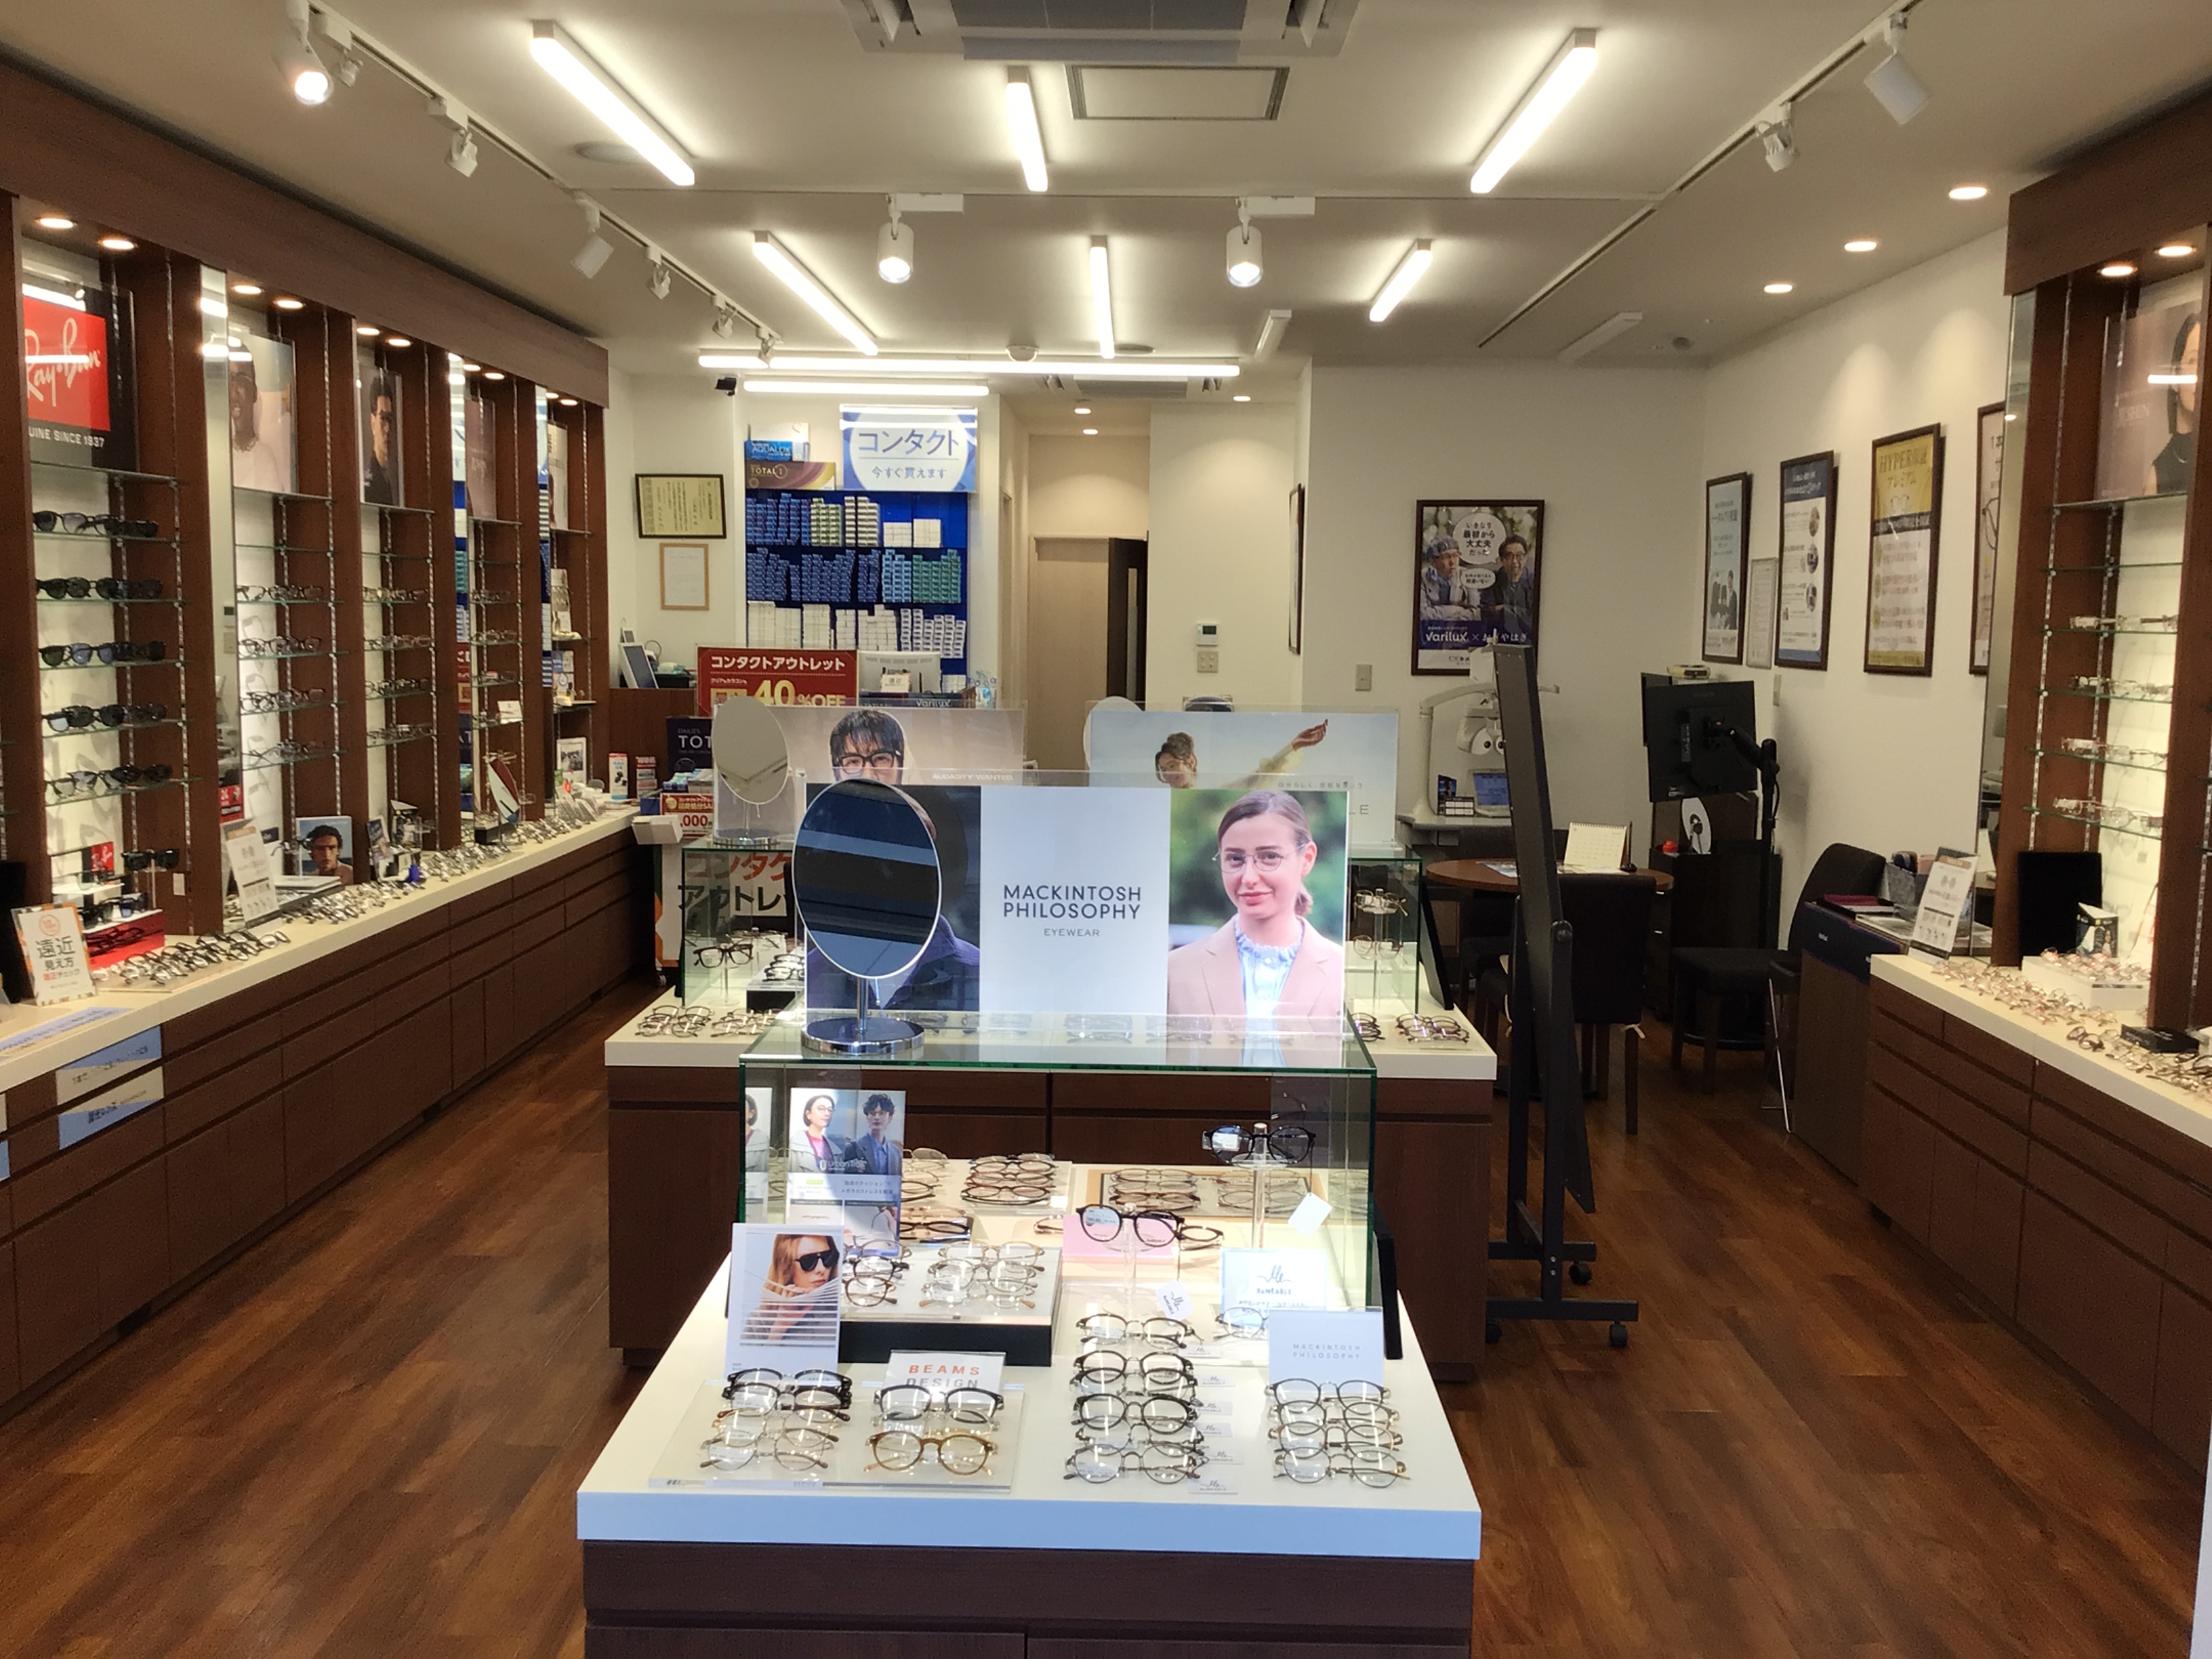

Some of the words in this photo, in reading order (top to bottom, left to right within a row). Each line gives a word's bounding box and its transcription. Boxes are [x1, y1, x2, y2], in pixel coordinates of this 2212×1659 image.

[54, 430, 81, 445] SINCE
[83, 435, 105, 447] 1937
[859, 429, 960, 456] コンタクト
[872, 466, 947, 479] 今すぐ買えます
[1464, 530, 1495, 539] 最初から
[1426, 631, 1469, 642] Varilux
[711, 656, 846, 671] コンタクトアウトレット
[1004, 884, 1141, 901] MACKINTOSH
[1004, 902, 1141, 920] PHILOSOPHY
[1044, 928, 1100, 937] EYEWEAR
[35, 935, 75, 959] 遠近
[45, 957, 74, 971] 見え方
[908, 1364, 981, 1376] BEAMS
[906, 1377, 979, 1389] DESIGN
